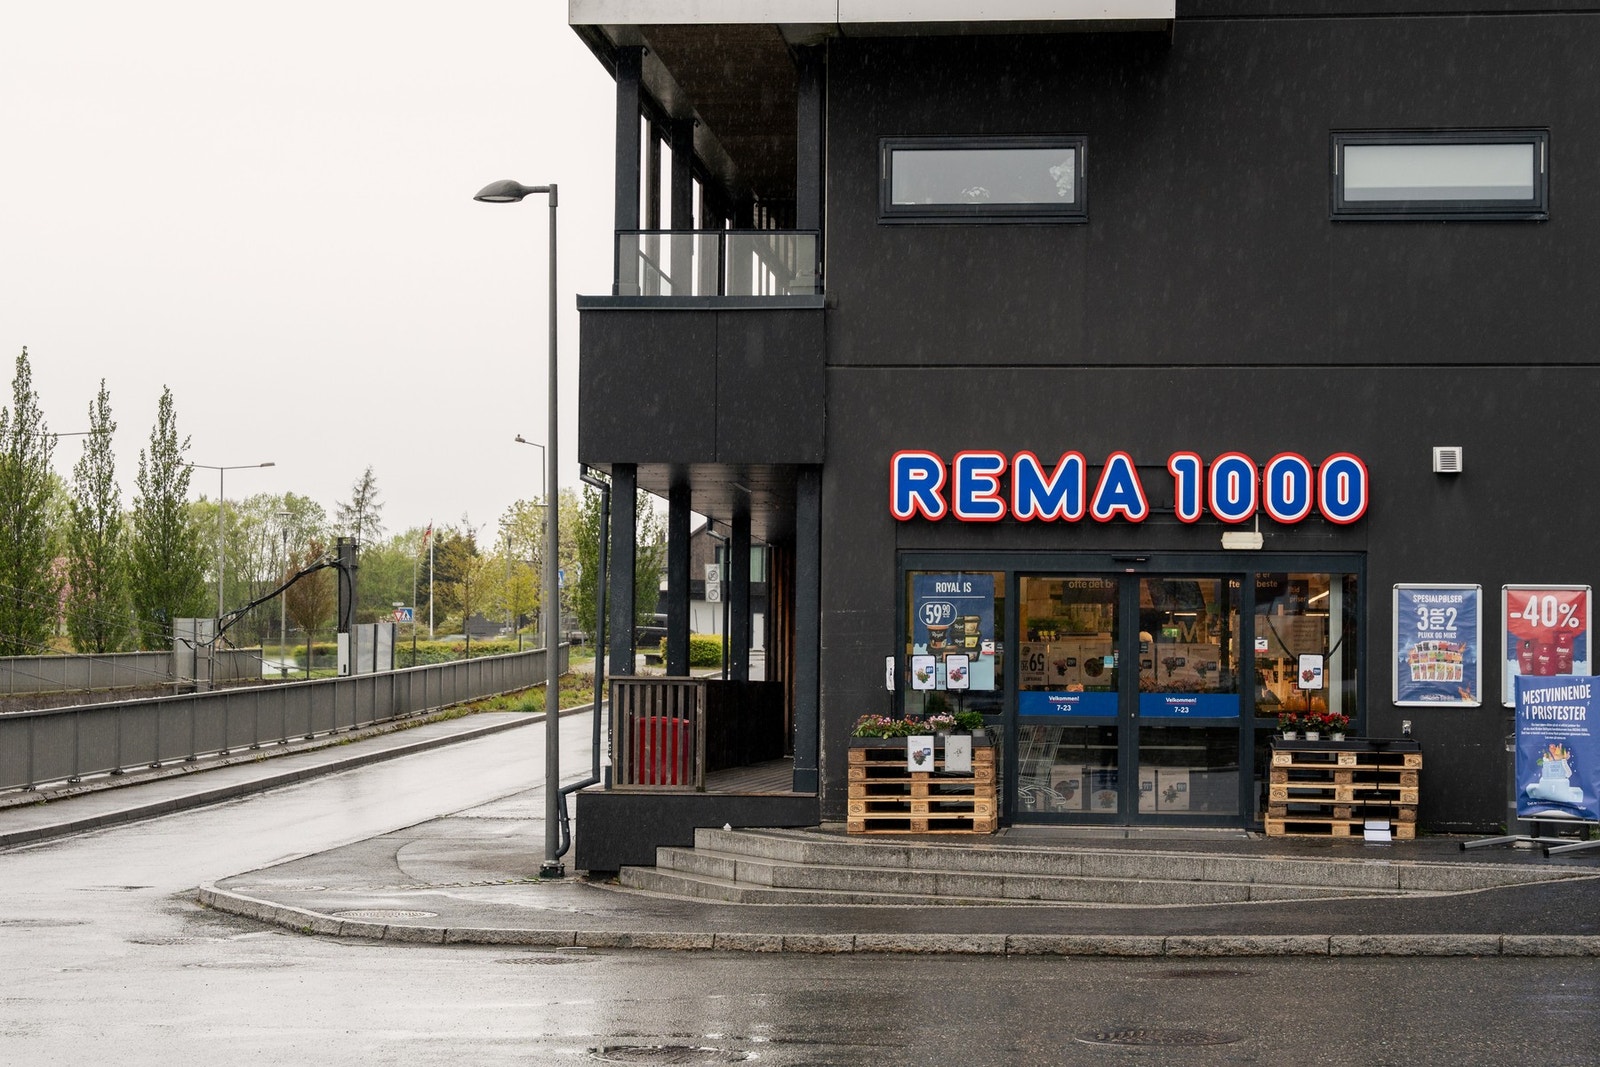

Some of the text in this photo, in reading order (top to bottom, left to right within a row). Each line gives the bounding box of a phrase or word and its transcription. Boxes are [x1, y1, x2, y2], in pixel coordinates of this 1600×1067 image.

[890, 450, 1369, 524] REMA 1000
[935, 582, 972, 593] ROYAL IS
[1256, 580, 1278, 588] beste
[1412, 594, 1463, 604] SPESIALPØLSER
[1416, 607, 1458, 631] 3 FOR 2
[1510, 595, 1580, 628] -40%
[1522, 684, 1592, 705] MESTVINNENDE
[1174, 706, 1190, 714] 7-23
[1525, 706, 1586, 721] I PRISTESTER
